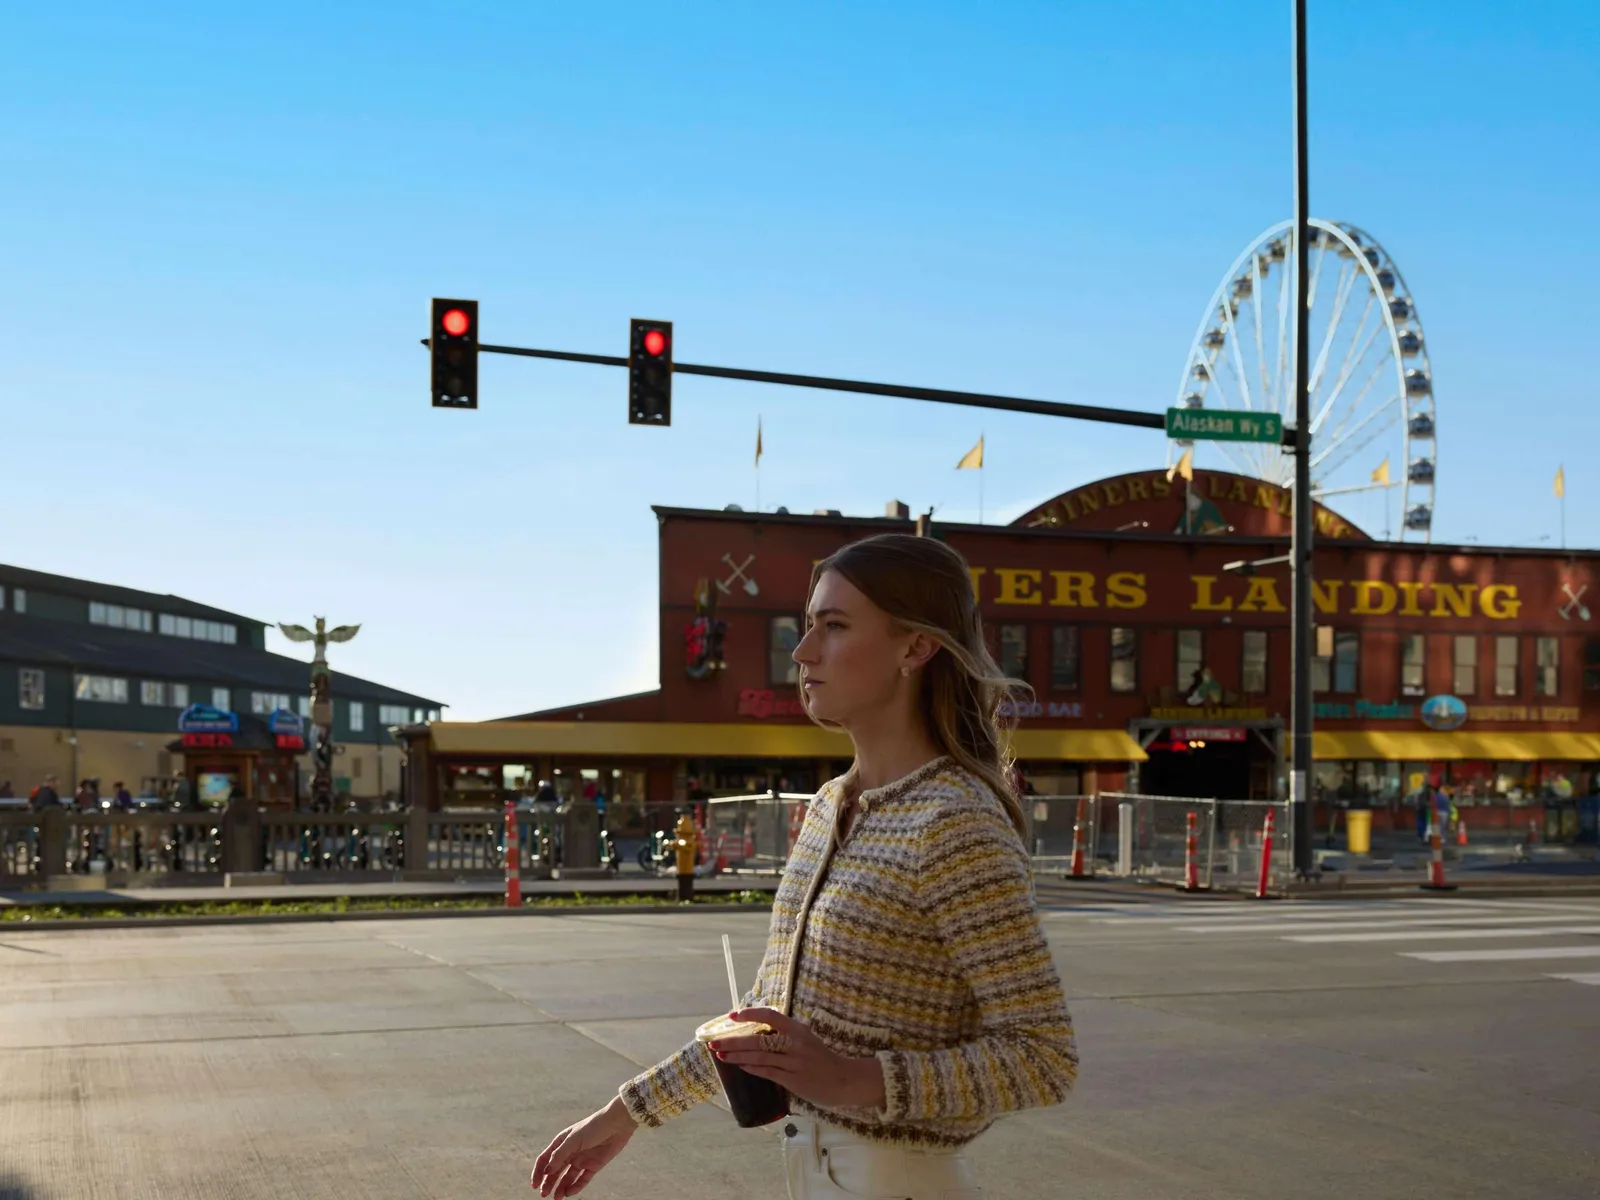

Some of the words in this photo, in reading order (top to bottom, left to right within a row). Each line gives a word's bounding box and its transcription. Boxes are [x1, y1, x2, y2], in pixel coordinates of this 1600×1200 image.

[1172, 412, 1234, 433] Alaskan
[1239, 419, 1260, 437] Wy
[1265, 420, 1275, 435] S
[1190, 575, 1523, 619] LANDING
